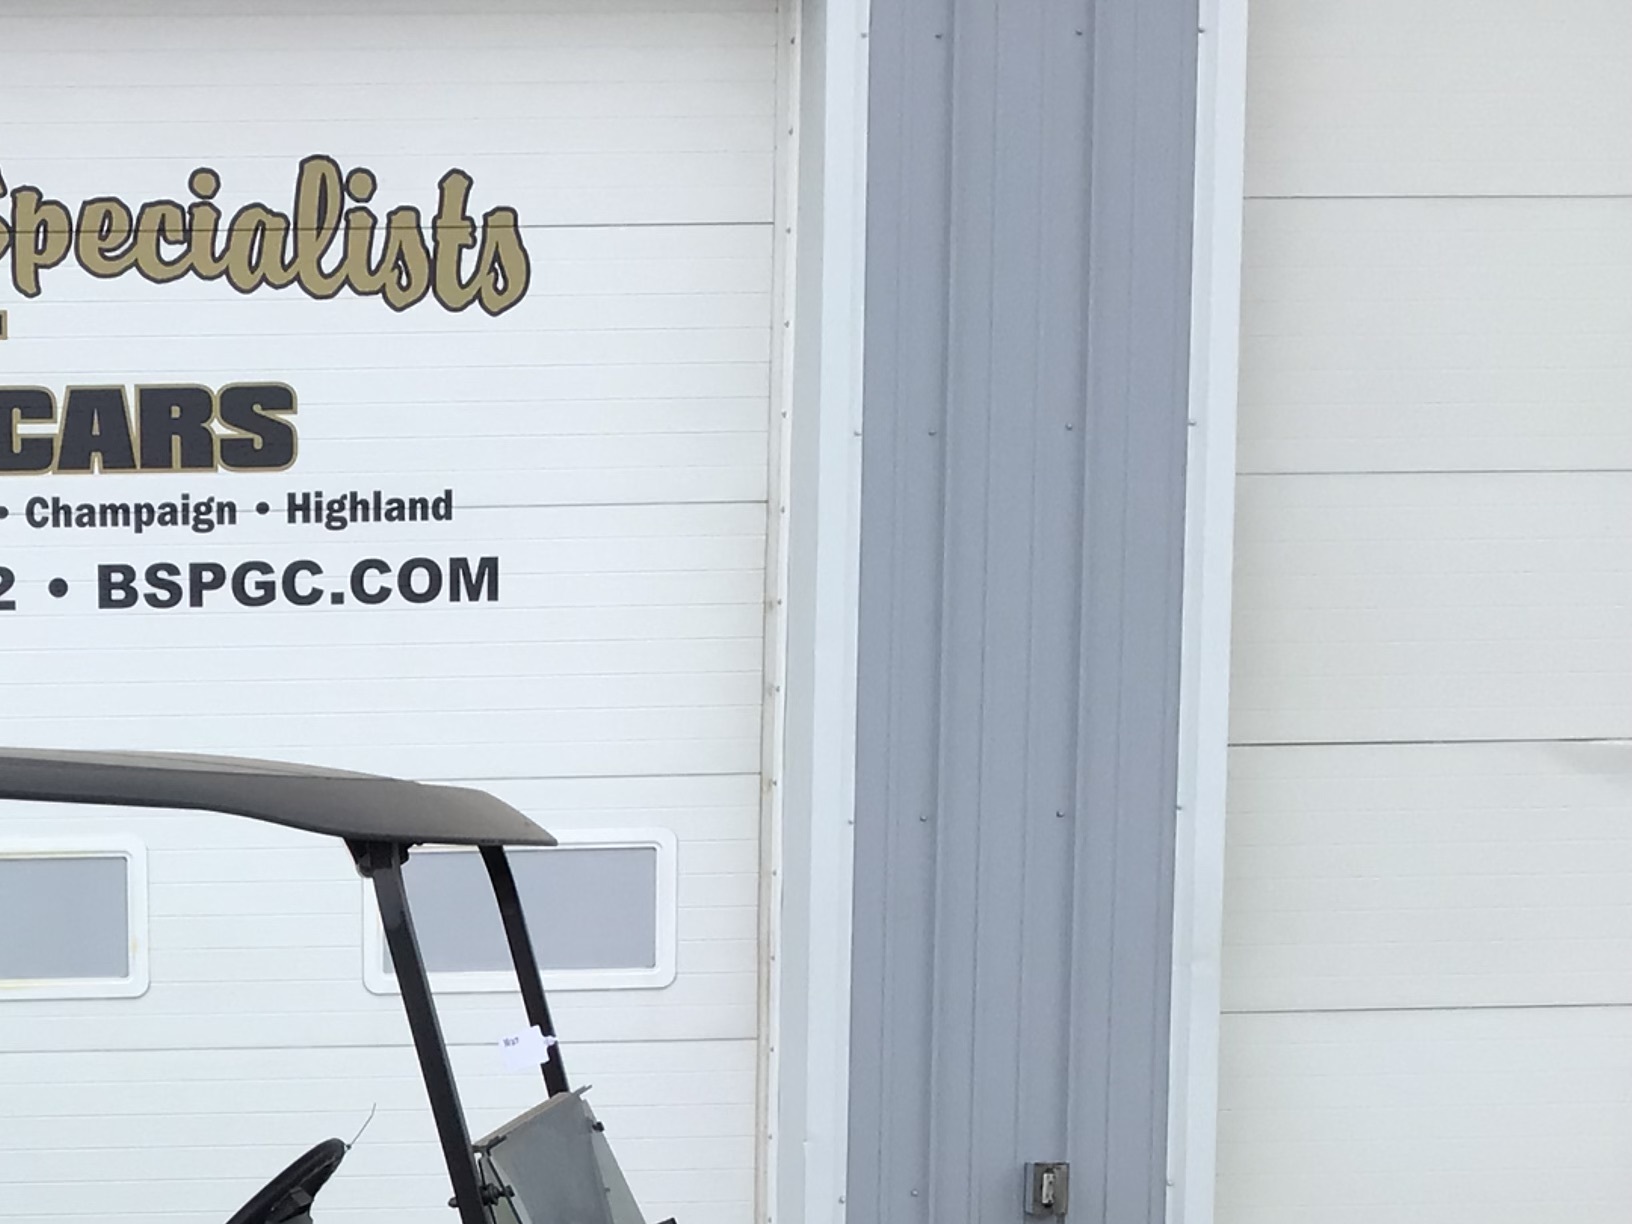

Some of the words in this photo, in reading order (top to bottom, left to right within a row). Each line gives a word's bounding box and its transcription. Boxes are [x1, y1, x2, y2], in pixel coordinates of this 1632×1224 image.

[24, 495, 238, 533] Champaign
[286, 490, 454, 529] Highland
[97, 557, 500, 608] BSPGC.COM
